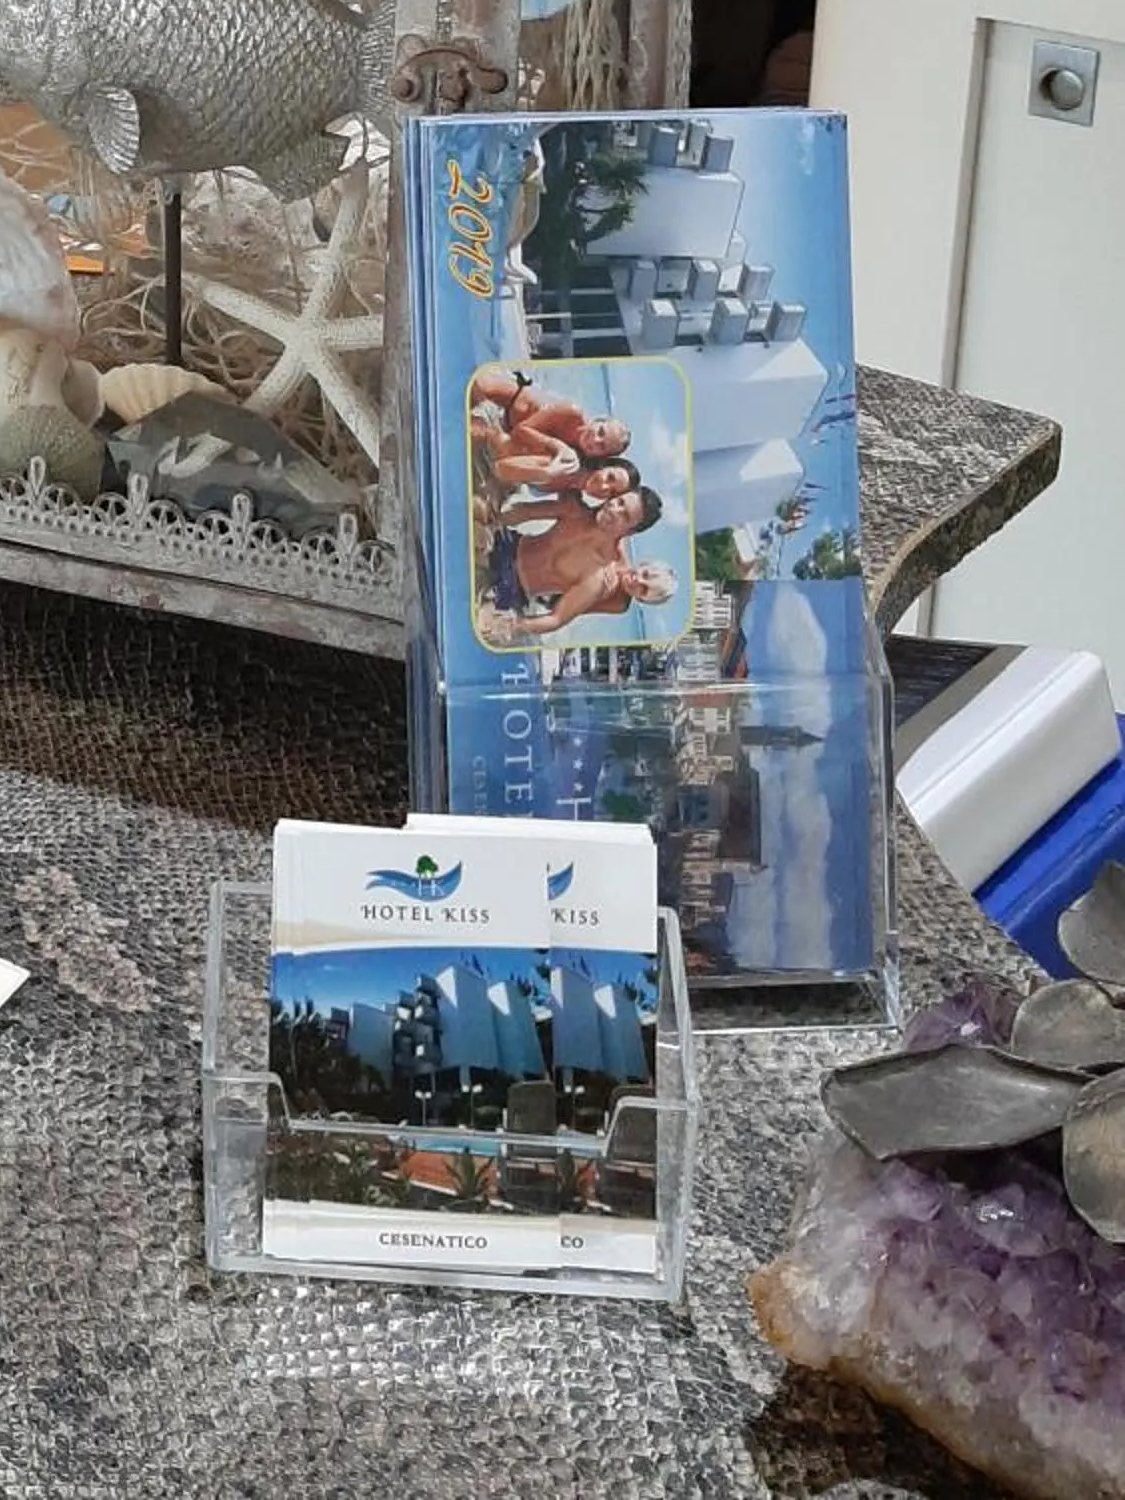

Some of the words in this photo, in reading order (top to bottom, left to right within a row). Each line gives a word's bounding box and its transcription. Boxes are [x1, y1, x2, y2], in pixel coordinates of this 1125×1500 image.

[447, 158, 494, 297] 2019
[501, 662, 534, 818] HOTE
[360, 904, 434, 922] HOTEL
[441, 907, 491, 924] KISS
[551, 908, 600, 926] KISS
[378, 1232, 488, 1249] CESENATICO
[560, 1235, 584, 1250] CO
